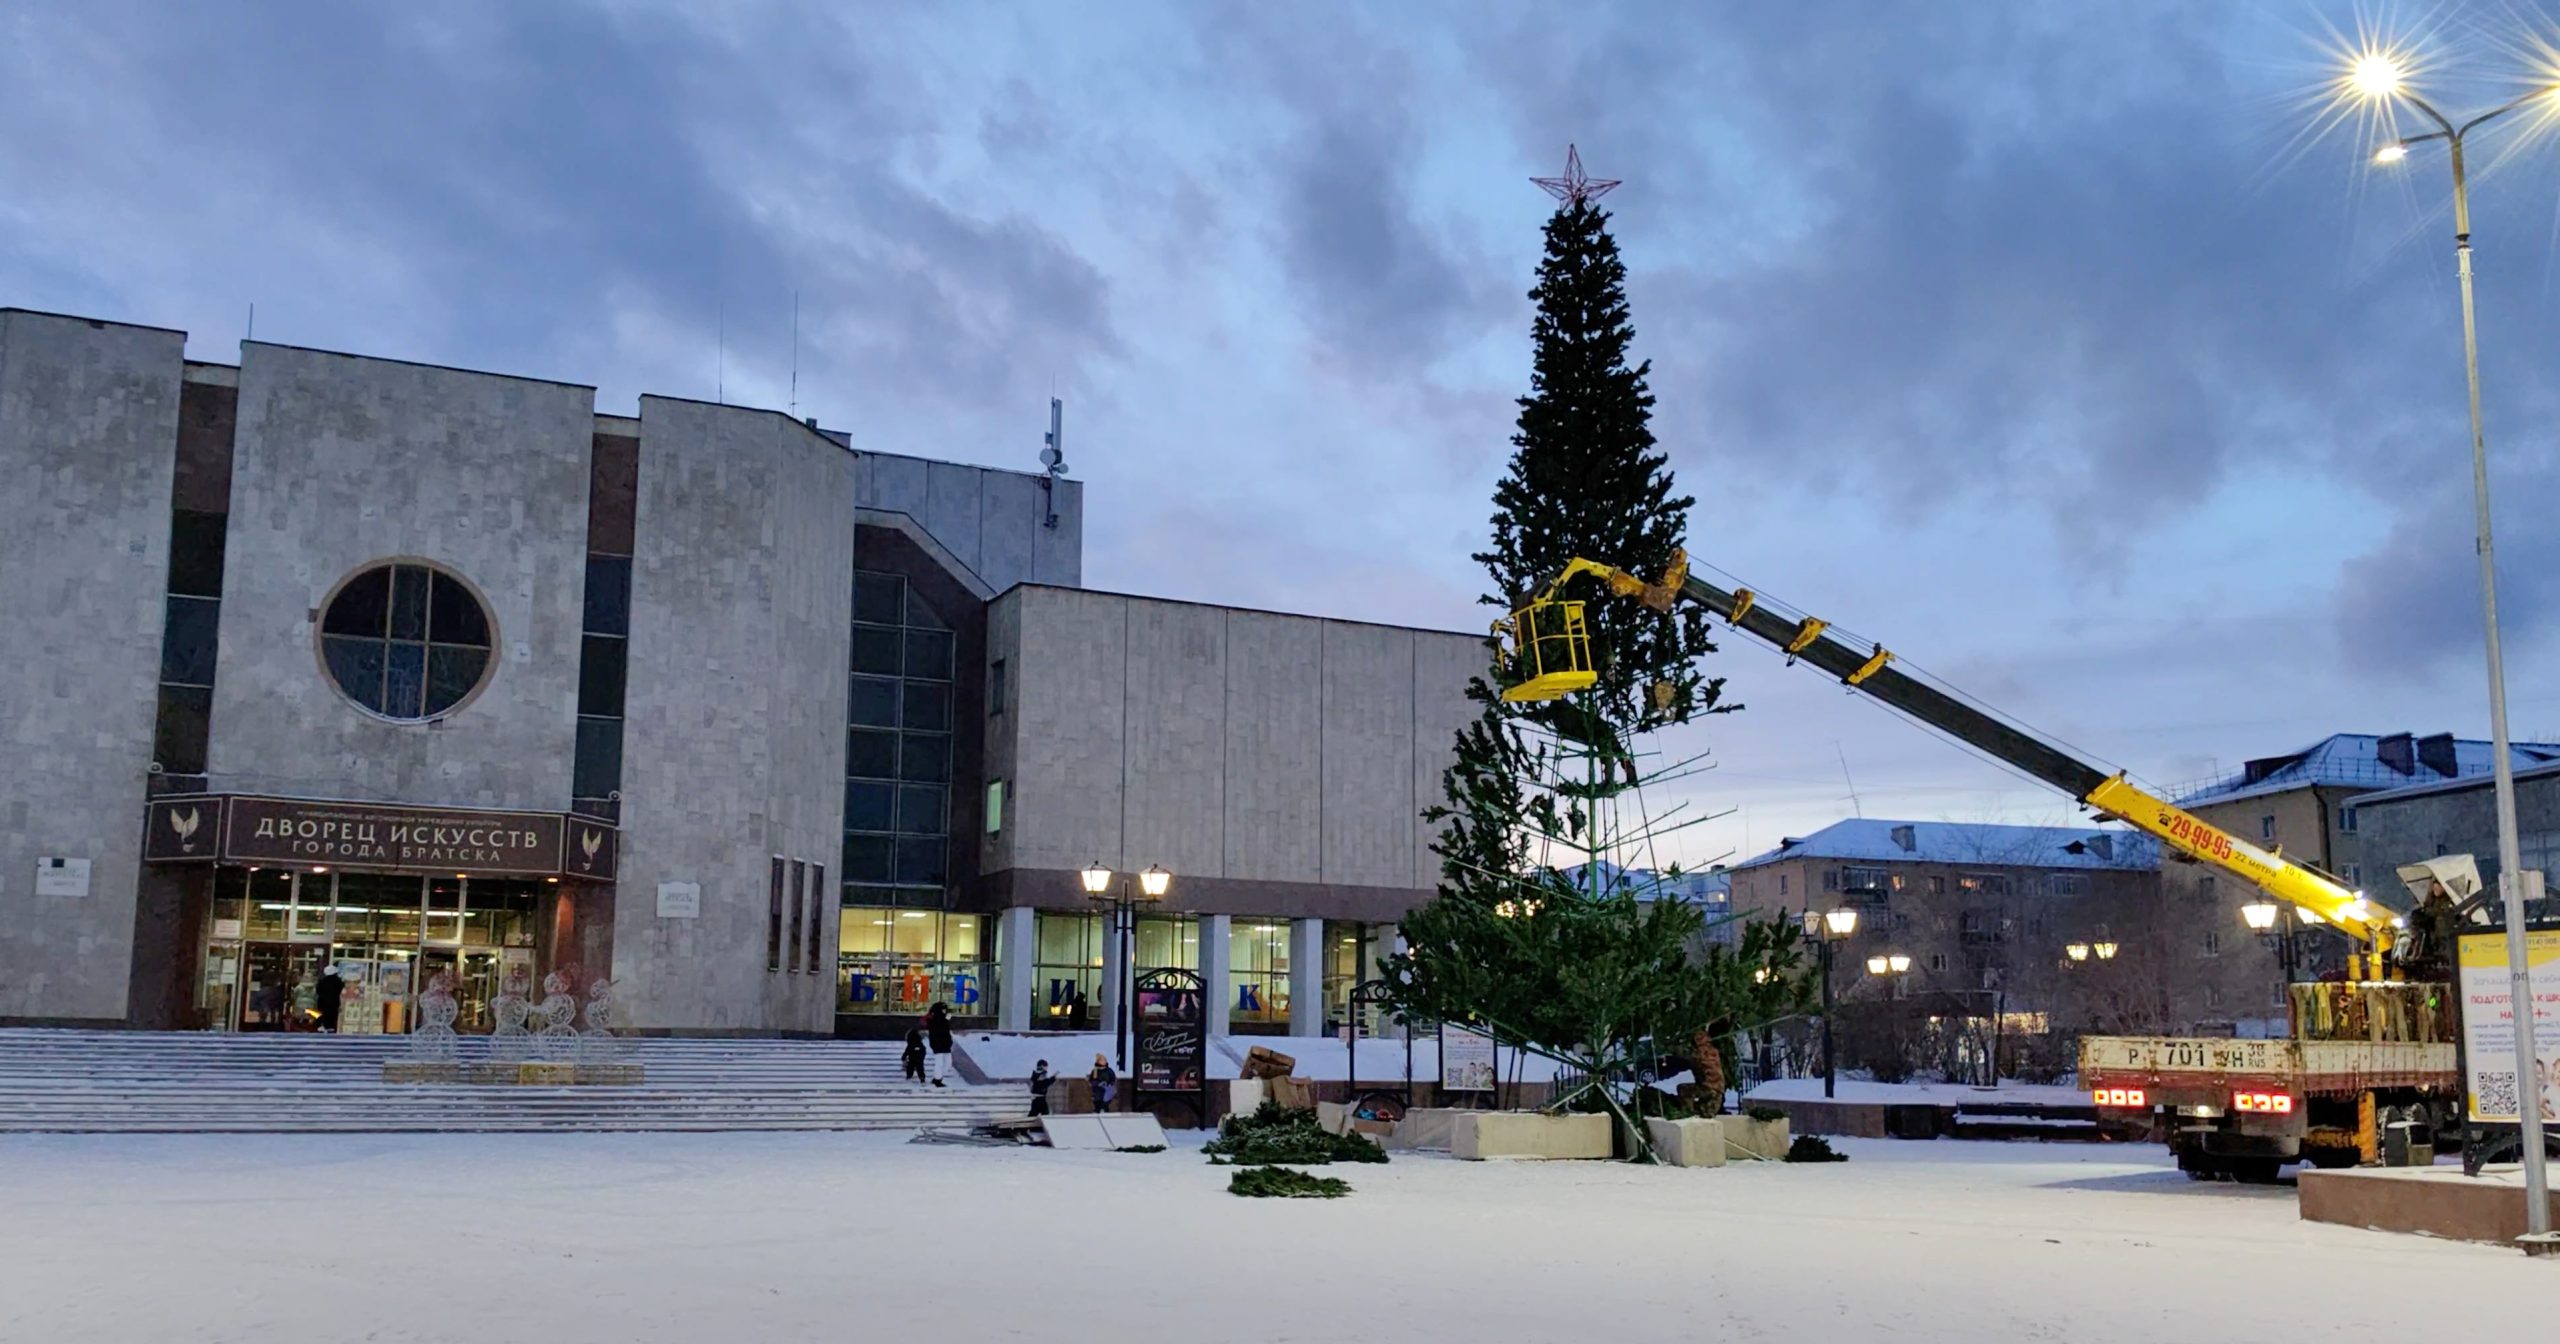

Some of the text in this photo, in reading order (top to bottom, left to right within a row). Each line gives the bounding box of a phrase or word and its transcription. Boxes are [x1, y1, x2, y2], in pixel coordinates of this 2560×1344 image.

[255, 818, 538, 848] ДВОРЕЦ ИСКУССТВ
[292, 840, 500, 861] ГОРОДА БРАТСКА
[2234, 851, 2247, 863] 22
[2248, 860, 2277, 878] метра
[2284, 865, 2295, 877] 10
[2500, 1011, 2513, 1020] НА
[2129, 1049, 2139, 1064] Р
[2164, 1043, 2205, 1067] 701
[2248, 1058, 2266, 1068] RUS
[1141, 1062, 1153, 1074] 12
